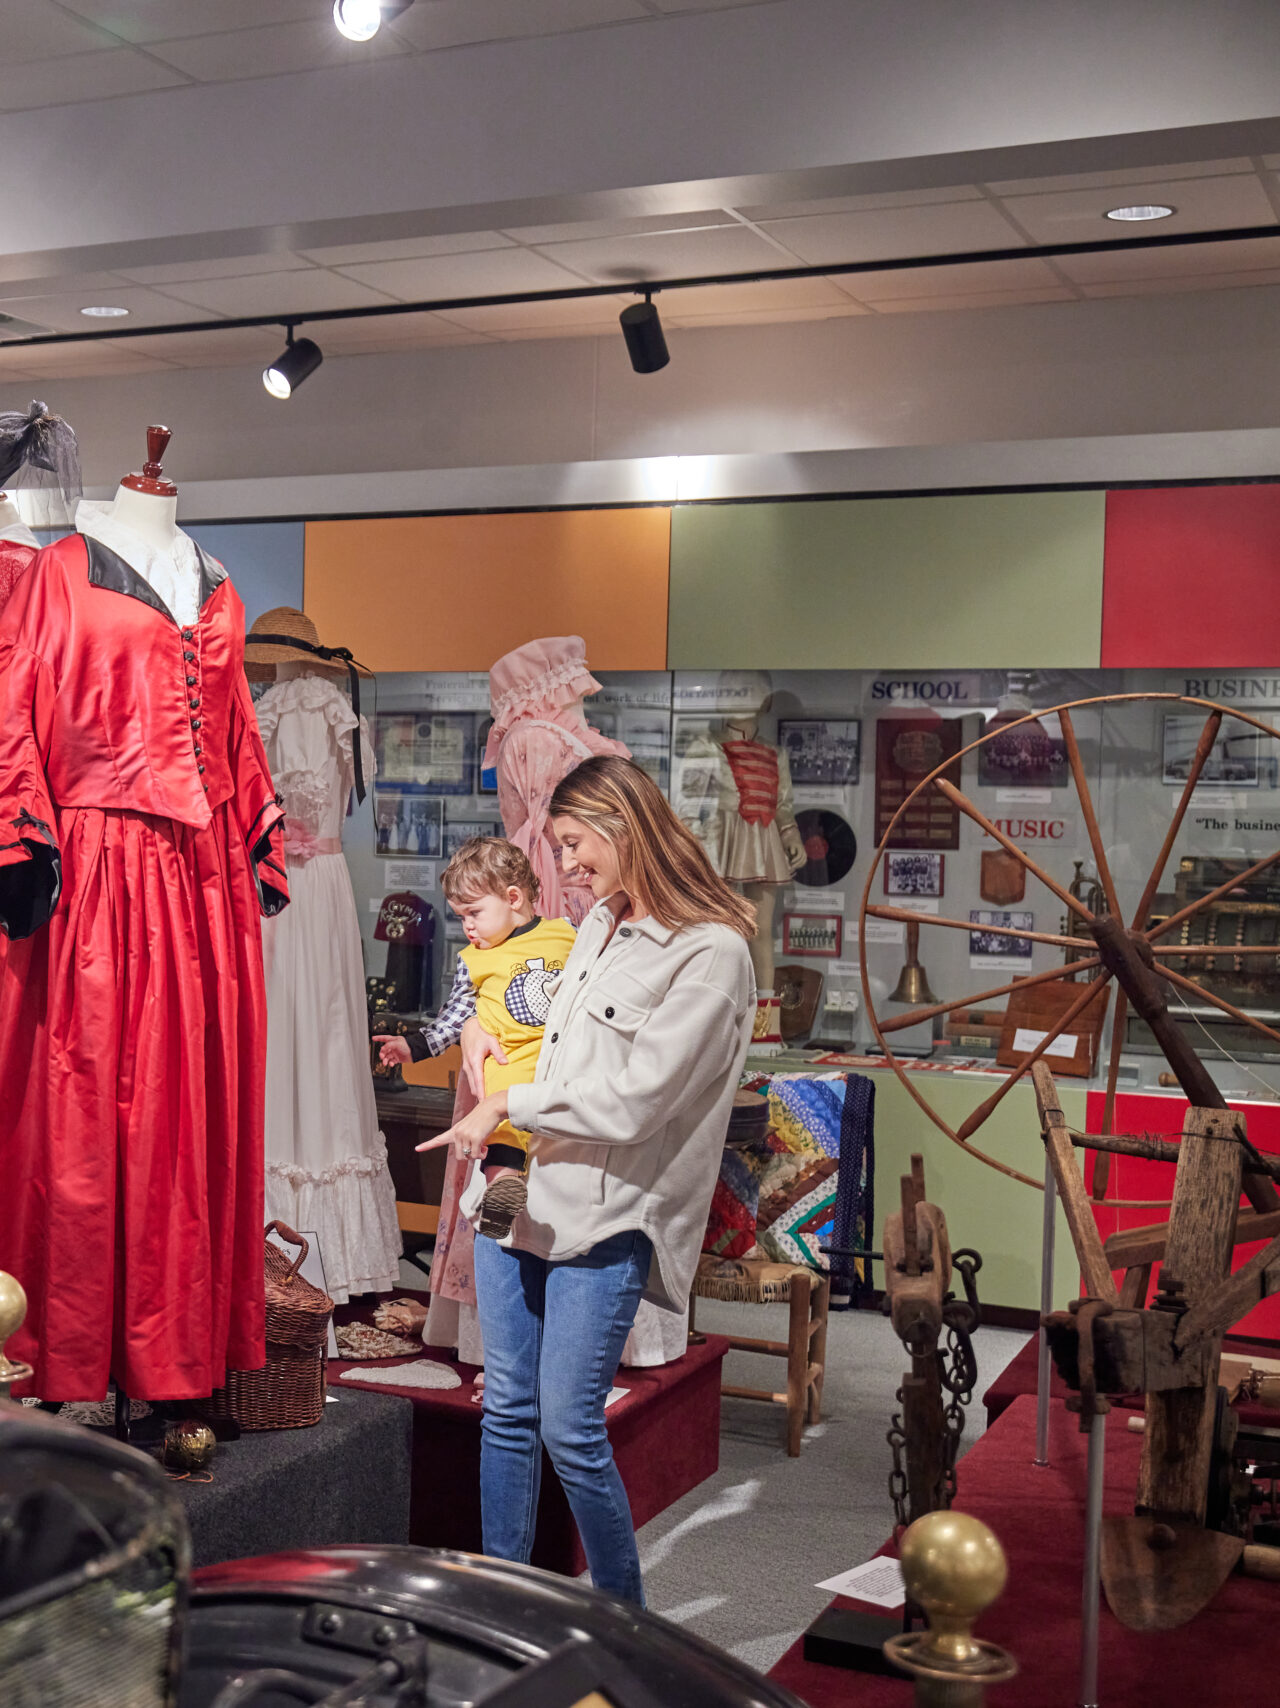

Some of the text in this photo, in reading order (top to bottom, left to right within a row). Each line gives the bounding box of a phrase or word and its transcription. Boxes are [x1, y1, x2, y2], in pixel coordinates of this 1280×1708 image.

[605, 692, 632, 702] work
[636, 693, 648, 701] of
[871, 681, 968, 699] SCHOOL
[983, 819, 1064, 839] MUSIC
